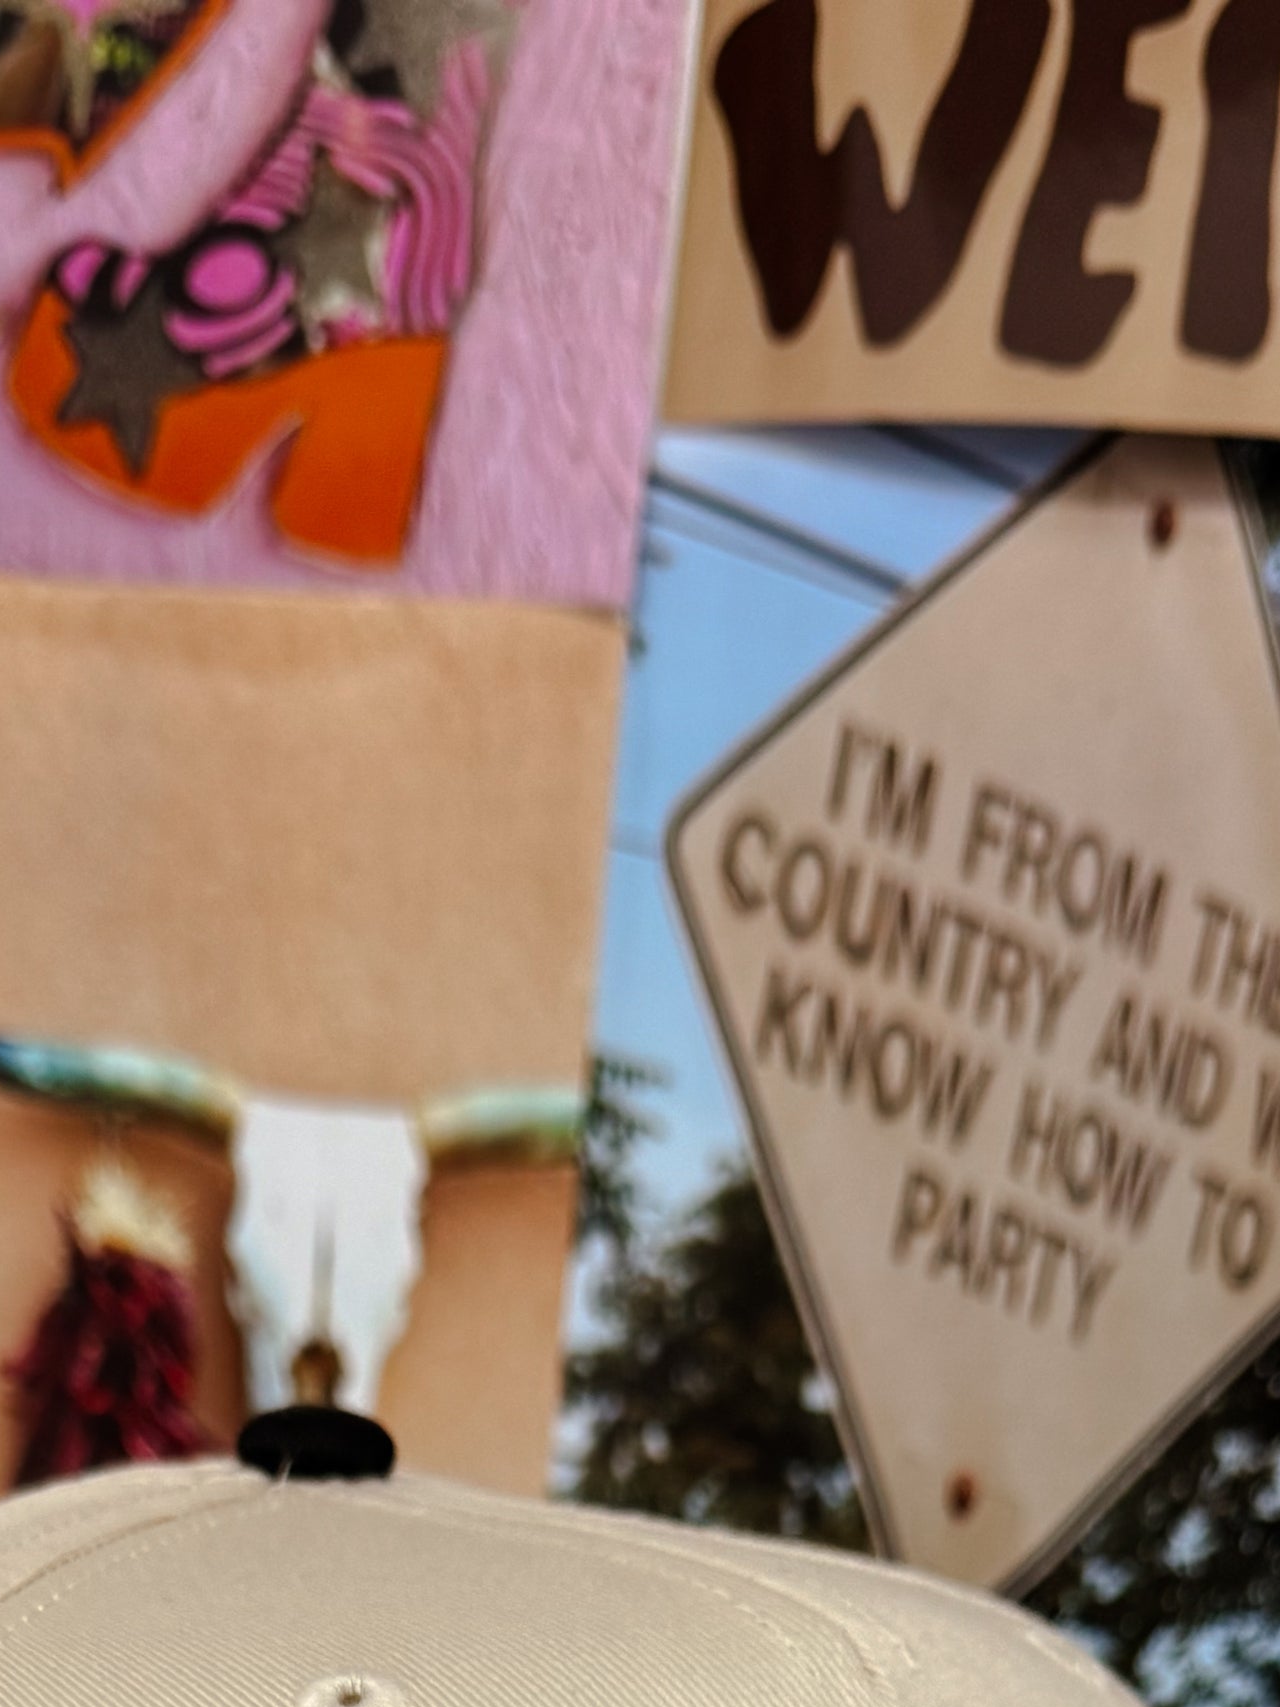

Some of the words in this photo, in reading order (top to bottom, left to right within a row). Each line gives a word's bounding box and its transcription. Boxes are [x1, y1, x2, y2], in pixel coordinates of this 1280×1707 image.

[719, 809, 1081, 1053] COUNTRY
[1092, 995, 1234, 1131] AND
[825, 718, 939, 857] I'M
[961, 781, 1170, 968] FROM
[754, 959, 996, 1153] KNOW
[1009, 1081, 1173, 1241] HOW
[1189, 1169, 1276, 1294] TO
[890, 1166, 1117, 1345] PARTY
